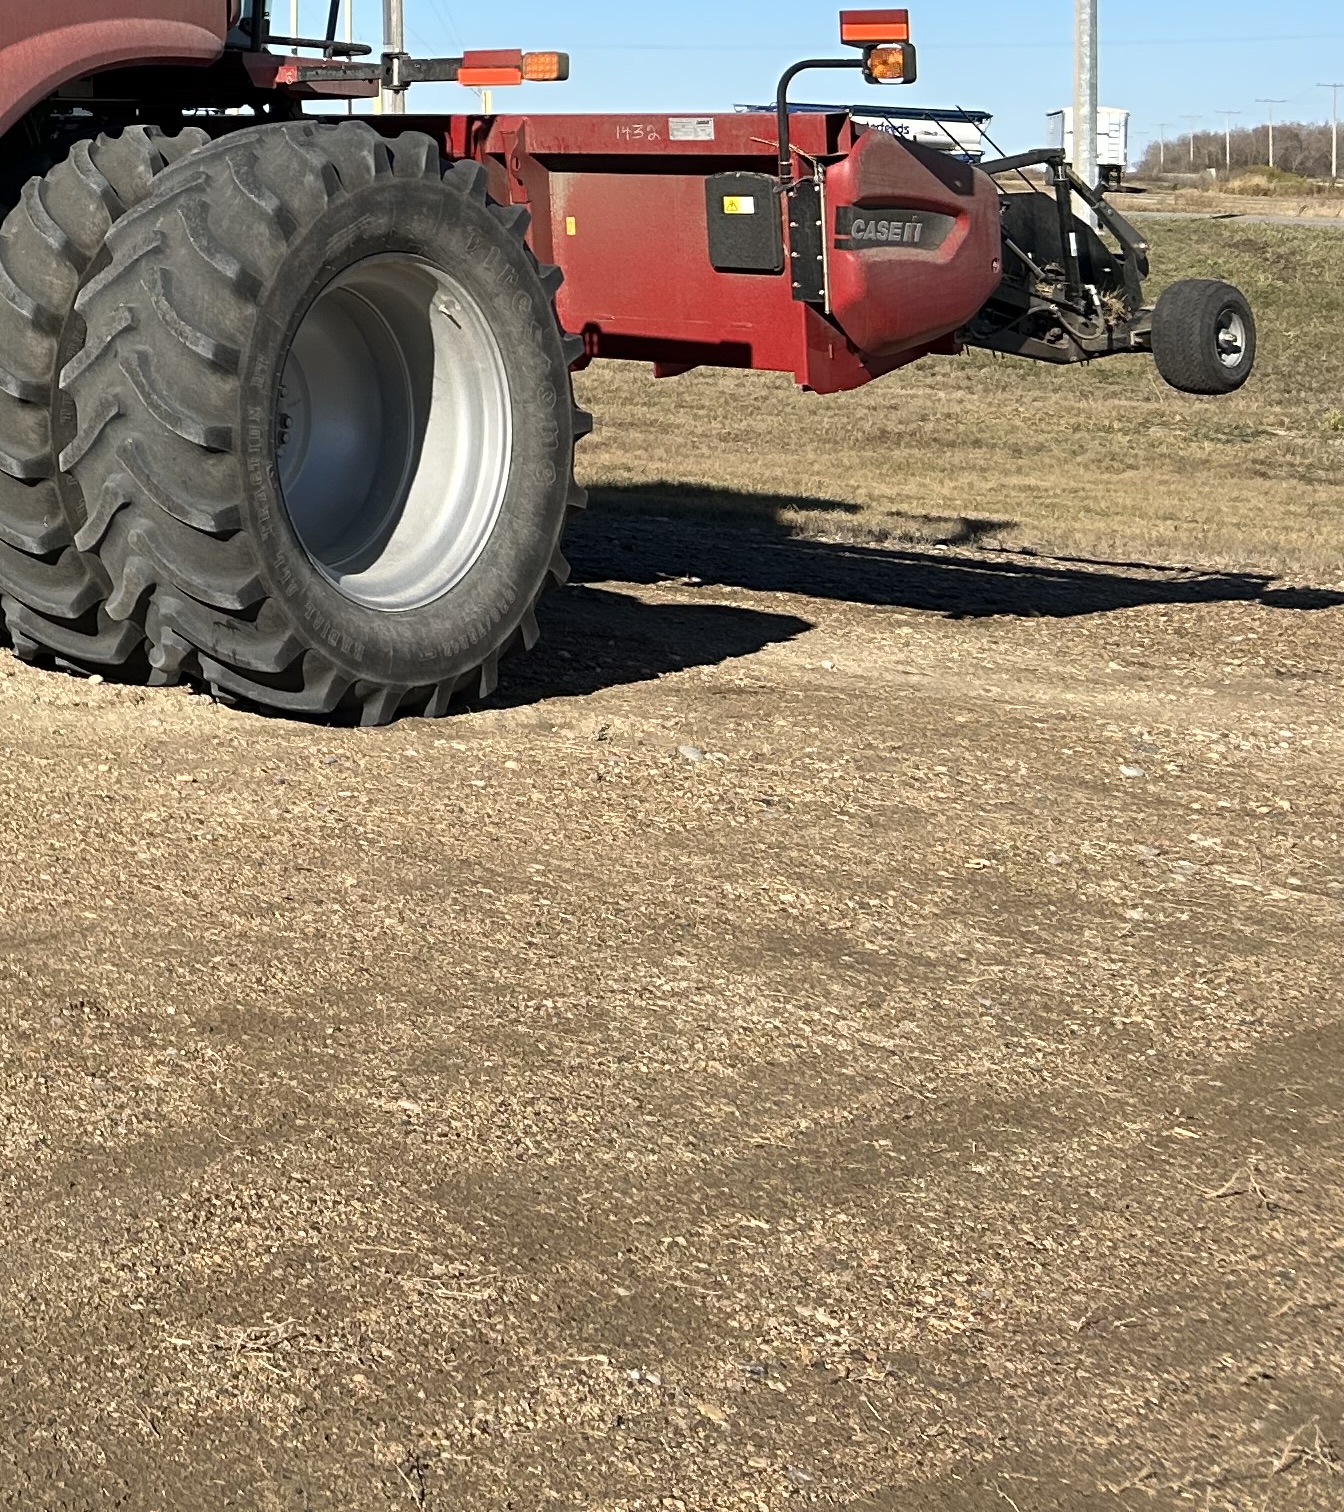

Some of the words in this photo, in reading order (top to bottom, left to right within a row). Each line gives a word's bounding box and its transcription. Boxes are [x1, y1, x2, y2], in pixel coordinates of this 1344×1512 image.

[615, 124, 662, 141] 1432
[851, 218, 903, 242] CASE
[247, 405, 273, 542] TRACTION
[273, 549, 299, 598] ALL
[303, 599, 366, 663] RADIAL
